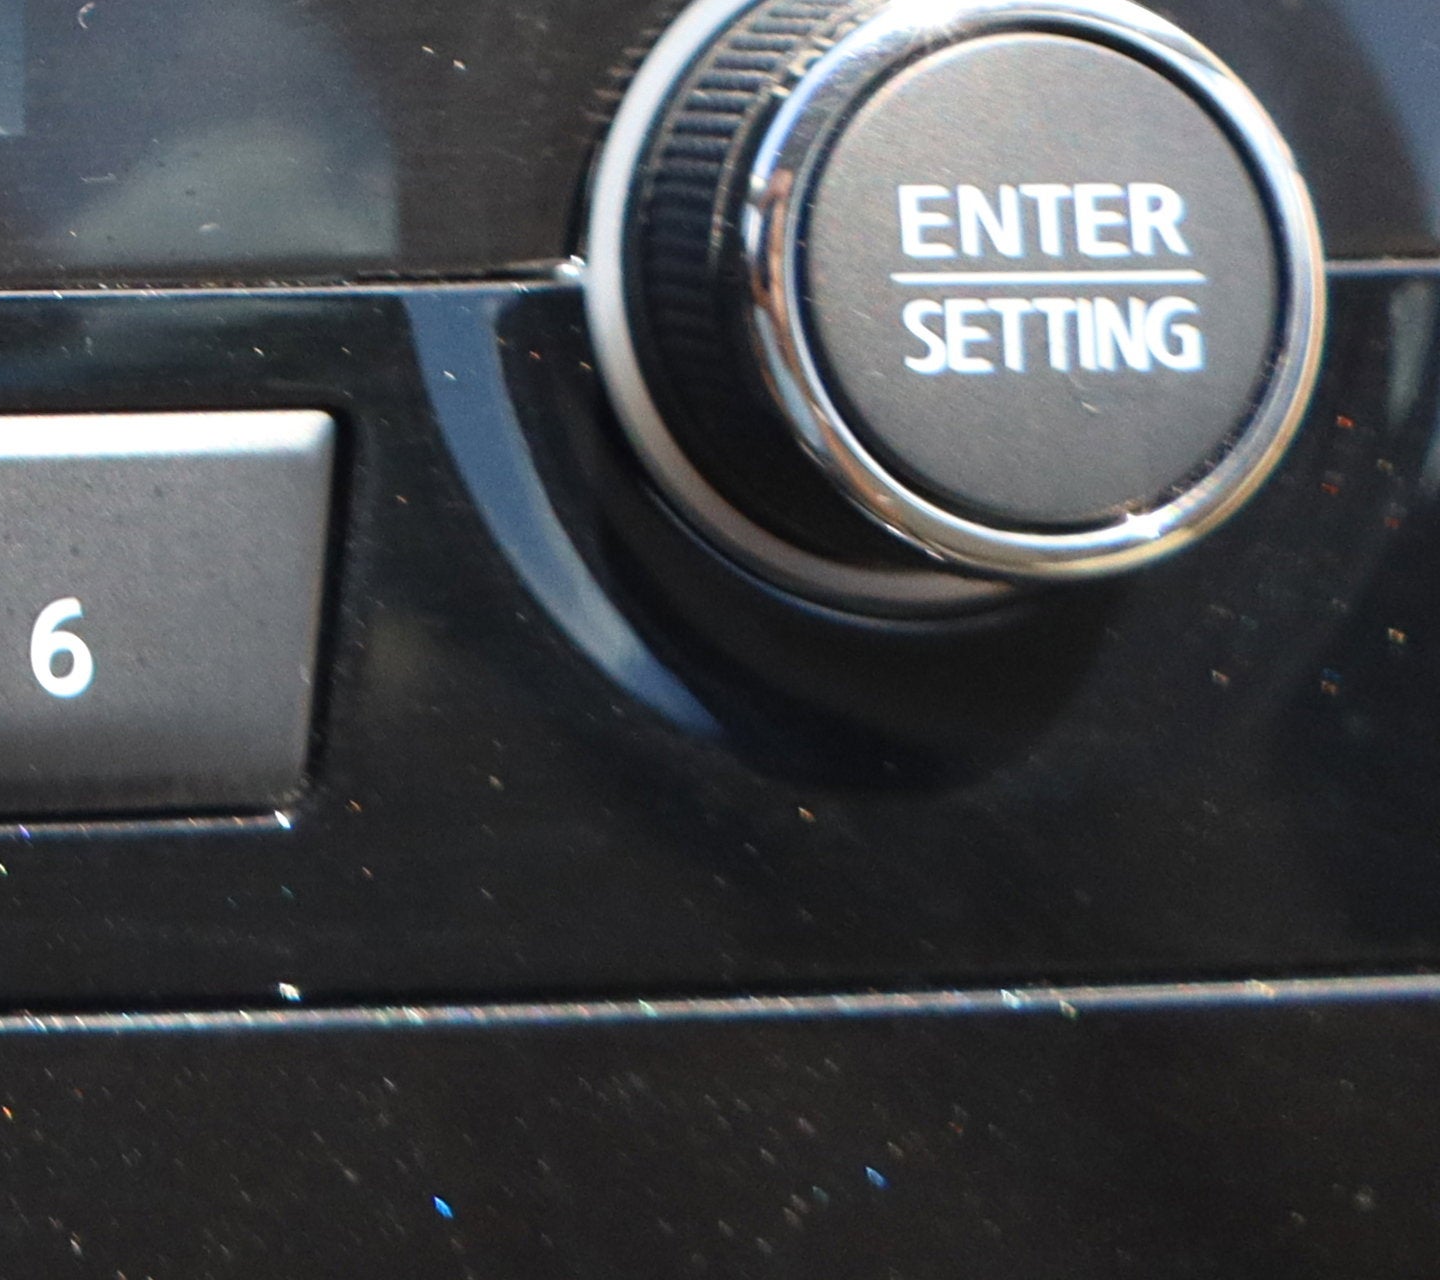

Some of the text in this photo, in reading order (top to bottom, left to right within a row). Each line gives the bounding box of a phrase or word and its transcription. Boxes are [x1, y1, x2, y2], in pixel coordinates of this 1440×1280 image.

[894, 182, 1192, 260] ENTER
[902, 296, 1206, 374] SETTING
[30, 596, 96, 700] 6
